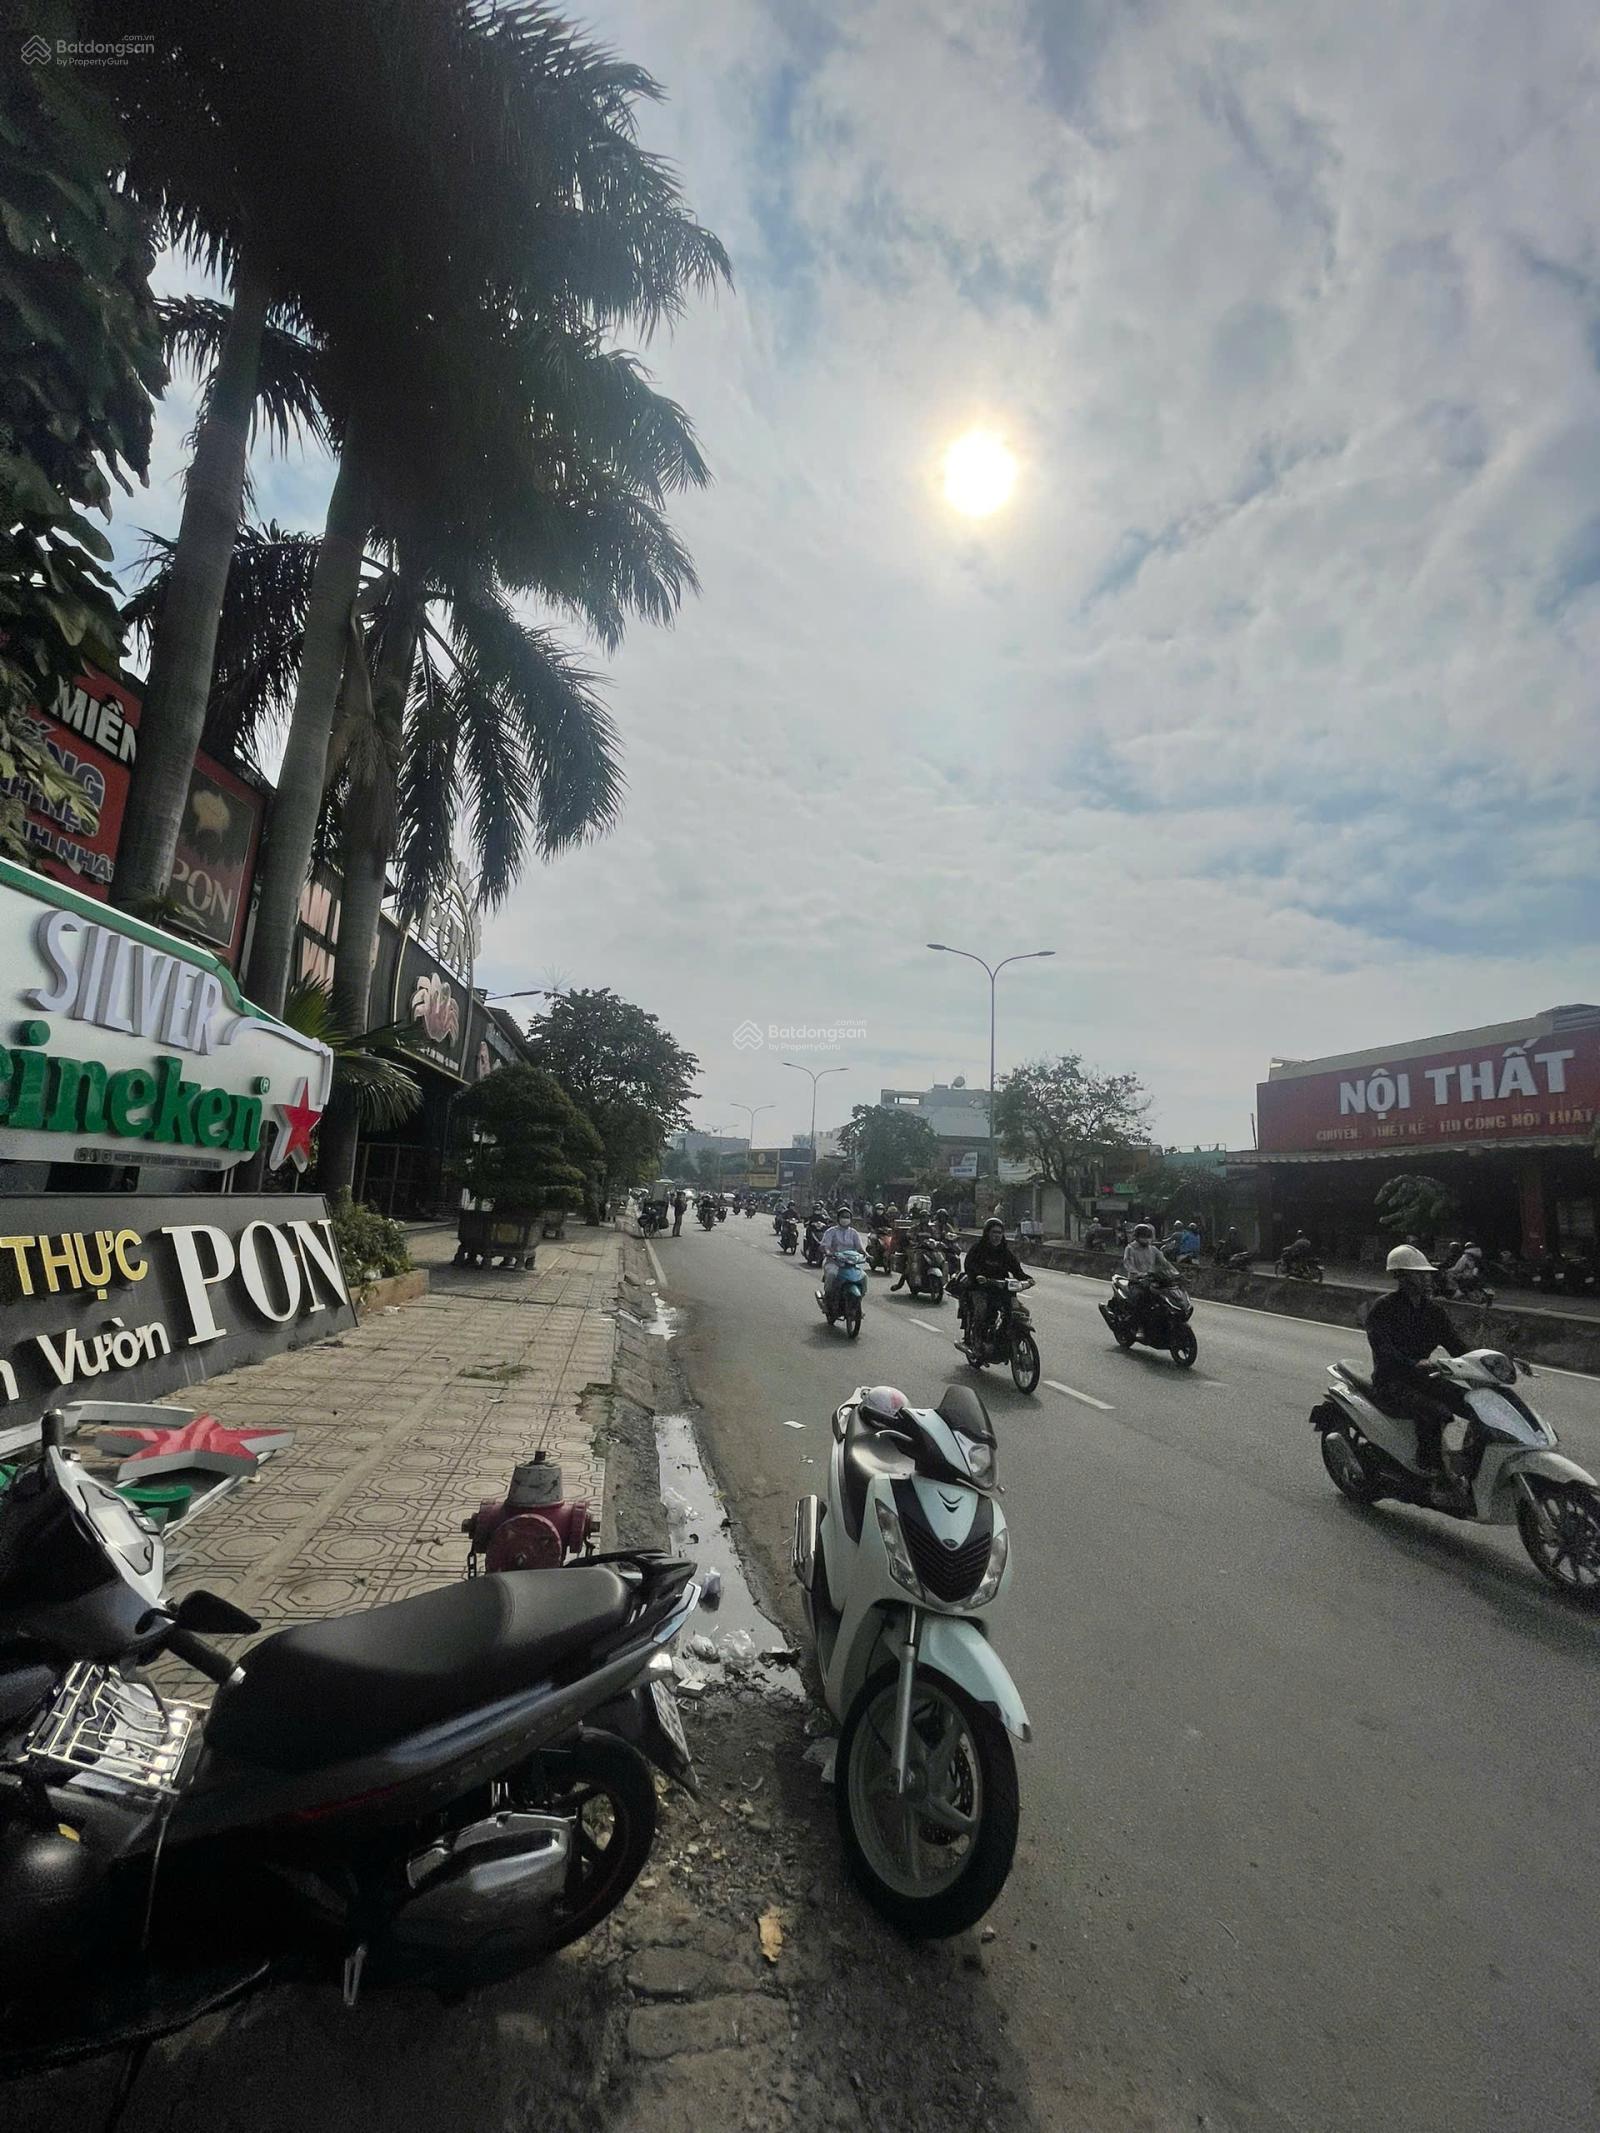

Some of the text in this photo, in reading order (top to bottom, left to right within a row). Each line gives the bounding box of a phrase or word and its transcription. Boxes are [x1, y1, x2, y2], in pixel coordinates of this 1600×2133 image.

[24, 909, 224, 1056] SILVER
[1340, 1037, 1575, 1121] NỘI THẤT
[0, 1228, 149, 1301] THỰC
[160, 1219, 348, 1345] PON
[37, 1316, 172, 1386] Vườn
